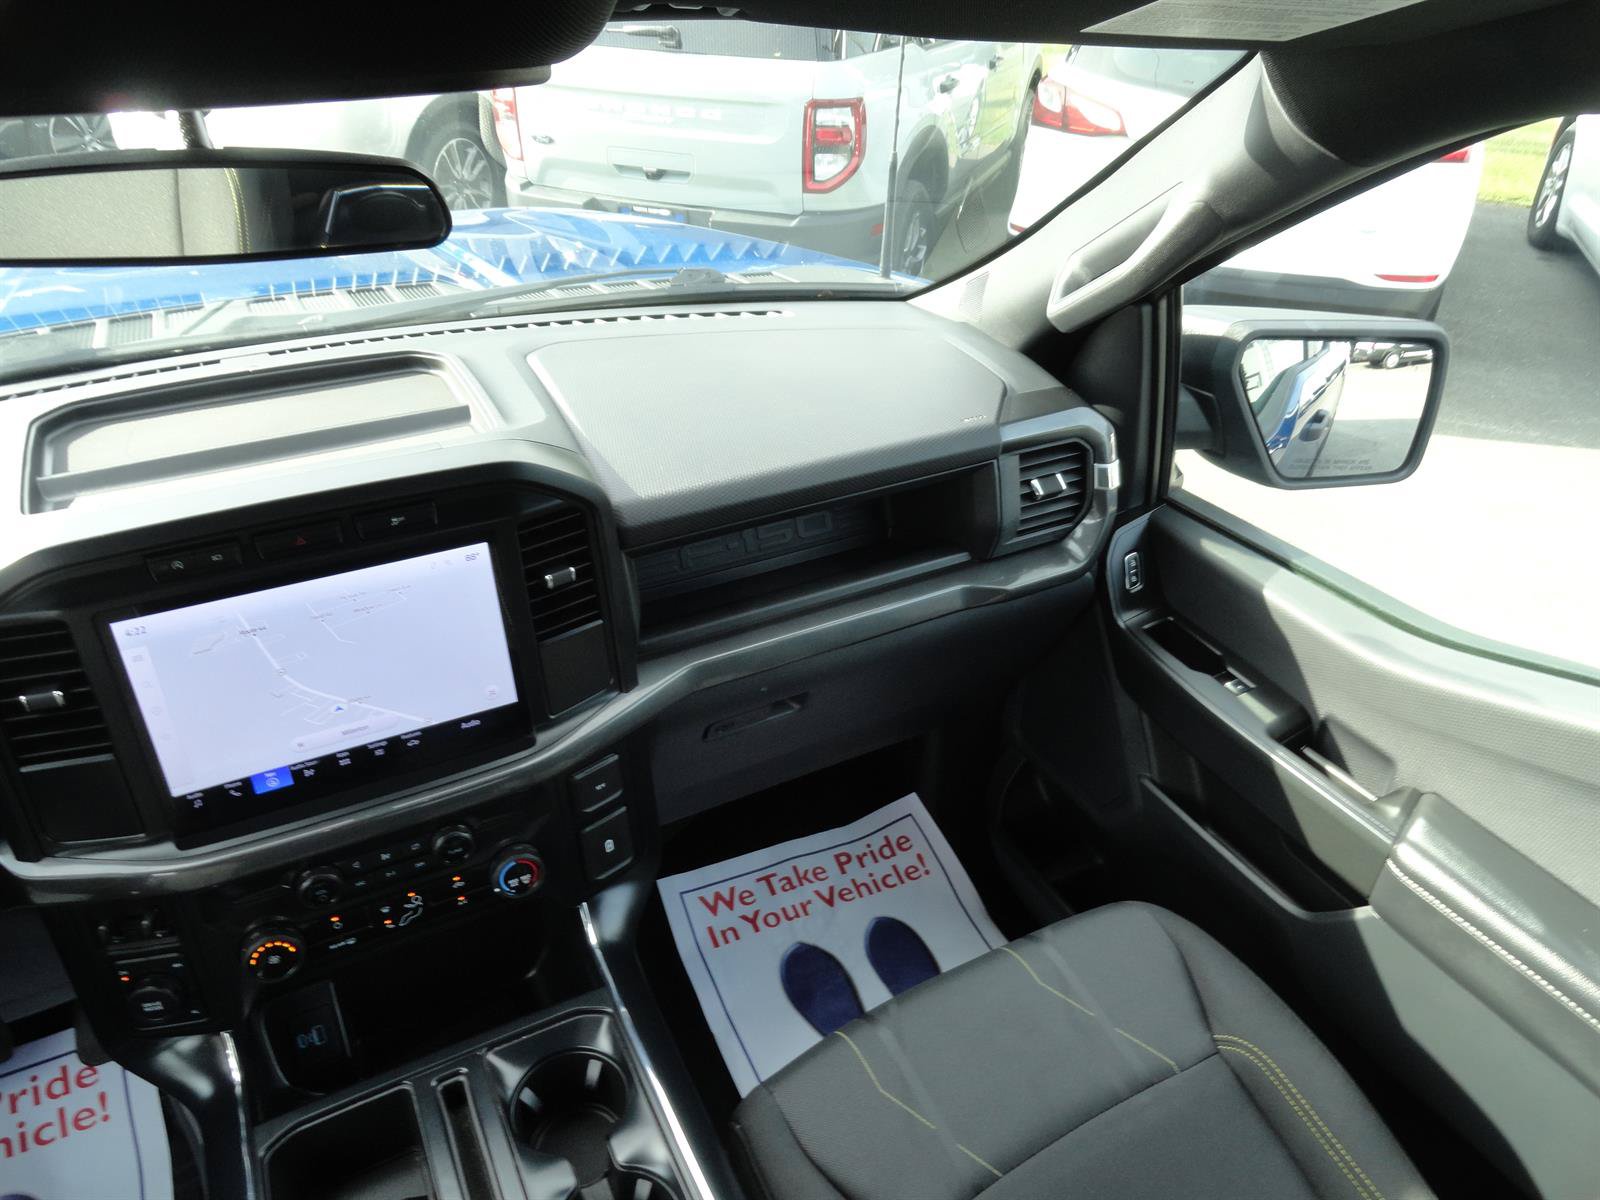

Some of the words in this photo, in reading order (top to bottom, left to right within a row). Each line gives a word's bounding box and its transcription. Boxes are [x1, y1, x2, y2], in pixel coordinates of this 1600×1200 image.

[698, 886, 757, 917] We
[756, 865, 829, 897] Take
[834, 834, 914, 875] Pride
[706, 925, 740, 949] In
[739, 898, 812, 934] Your
[814, 853, 931, 908] Vehicle!
[0, 1064, 100, 1115] ride
